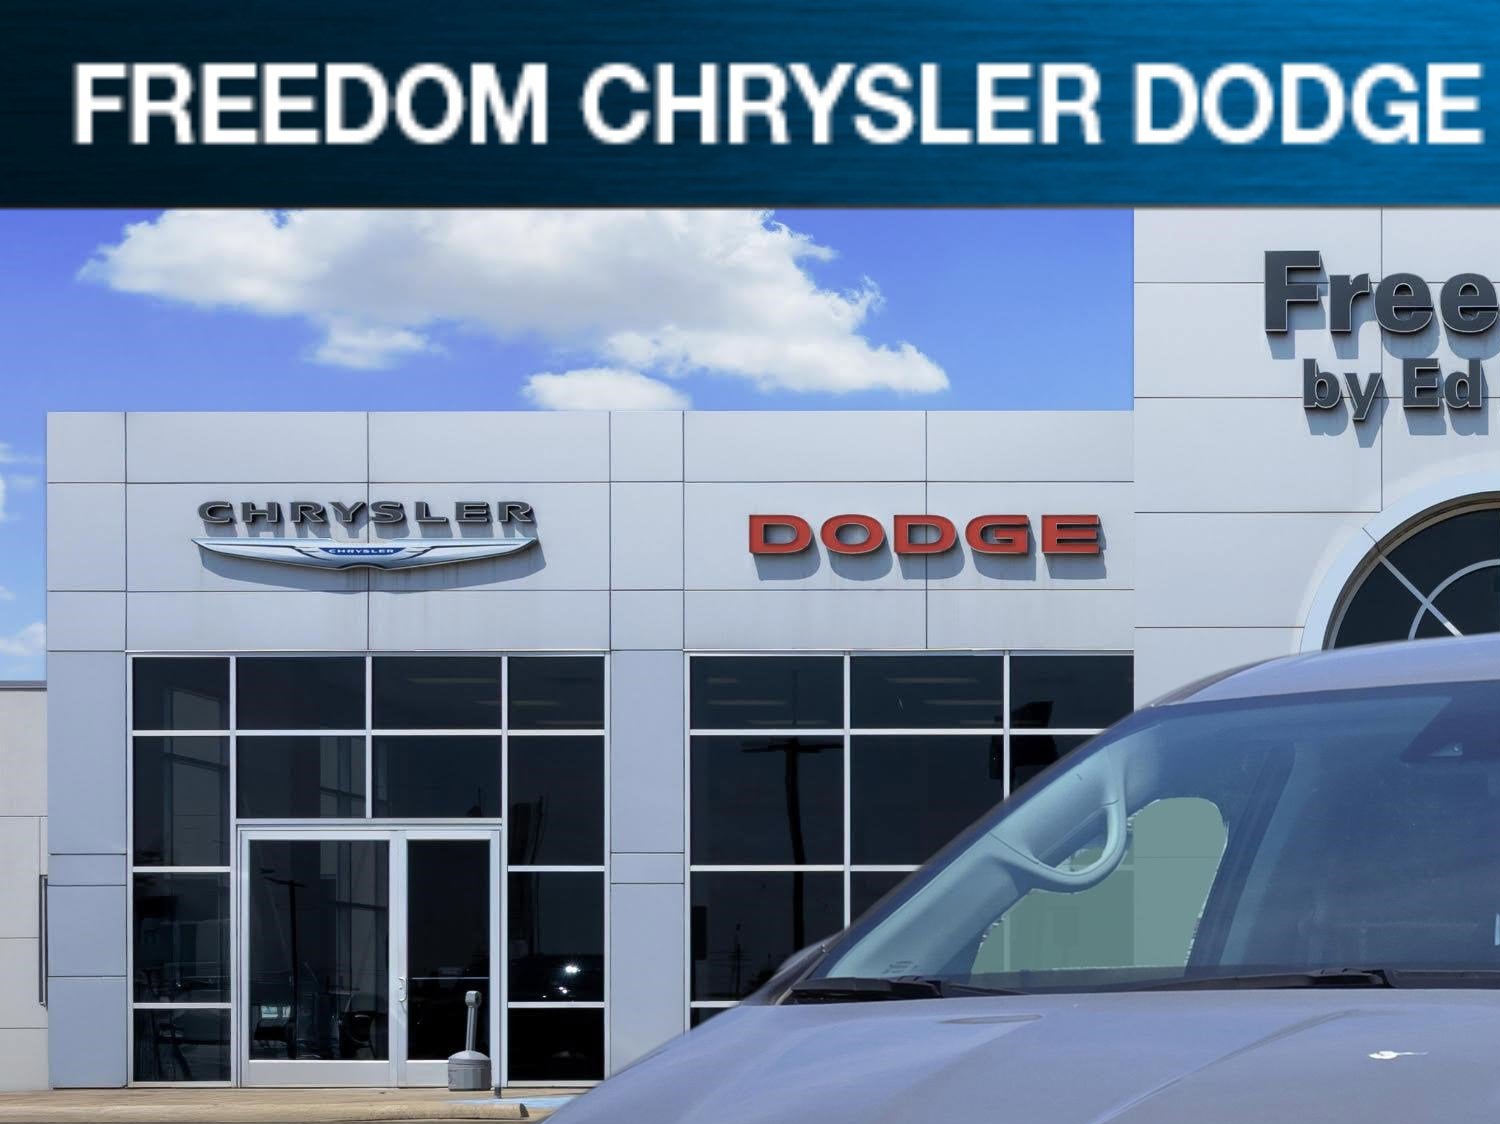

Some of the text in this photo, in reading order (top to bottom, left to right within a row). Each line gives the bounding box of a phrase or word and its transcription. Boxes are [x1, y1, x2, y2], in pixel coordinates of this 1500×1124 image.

[1303, 359, 1382, 421] by
[1402, 359, 1482, 409] Ed
[198, 500, 534, 524] CHRYSLER
[749, 513, 1101, 555] DODGE
